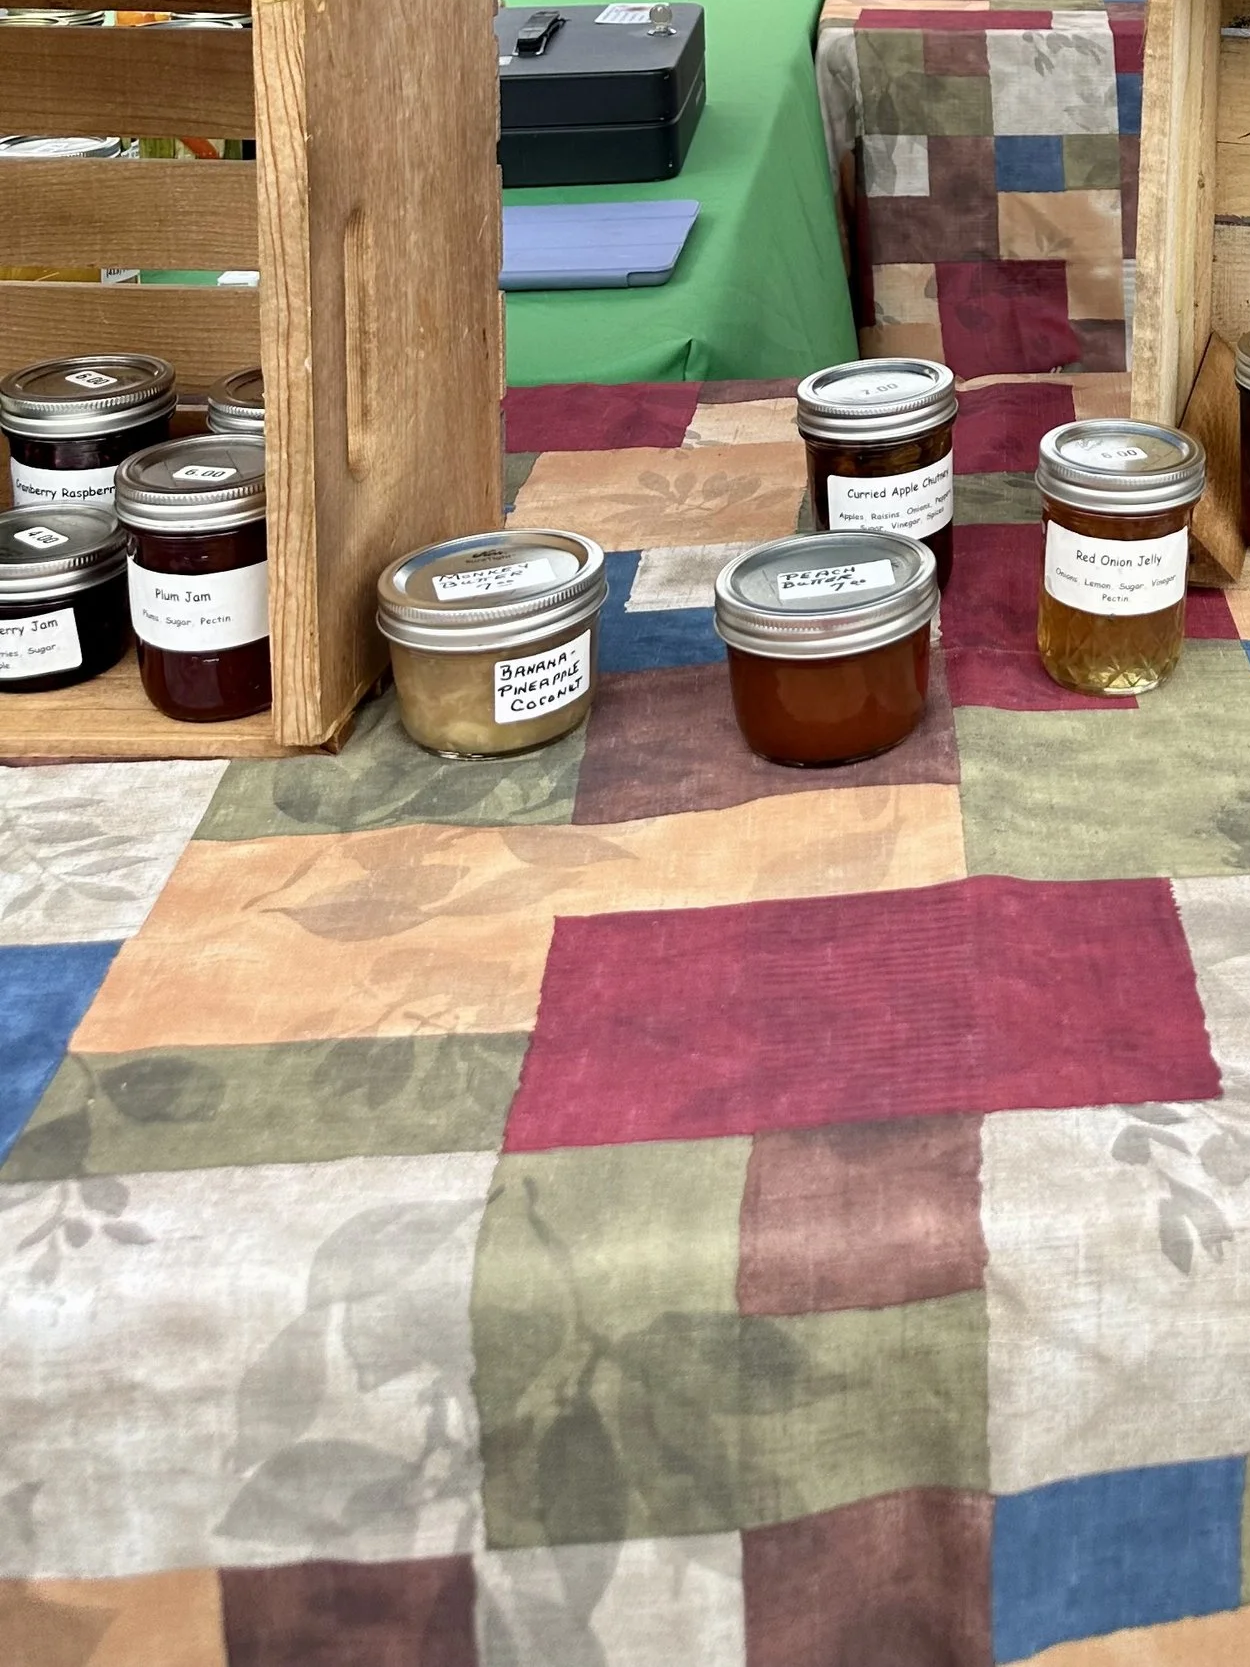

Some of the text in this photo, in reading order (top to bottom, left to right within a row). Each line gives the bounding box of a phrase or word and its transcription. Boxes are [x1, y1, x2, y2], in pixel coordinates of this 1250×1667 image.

[16, 478, 116, 500] Cranberry Raspberr
[847, 469, 949, 500] Curried Apple Chutney
[1076, 550, 1163, 567] Red Onion Jelly
[439, 563, 529, 582] MONKEY
[440, 570, 524, 590] BUTTER
[780, 566, 856, 581] PEACH
[782, 574, 853, 589] BUTTER
[155, 588, 212, 603] Plum Jam
[0, 618, 59, 636] erry Jam
[200, 614, 232, 625] Pectin
[498, 659, 581, 697] PINEAPPLE
[510, 675, 583, 712] COCONUT
